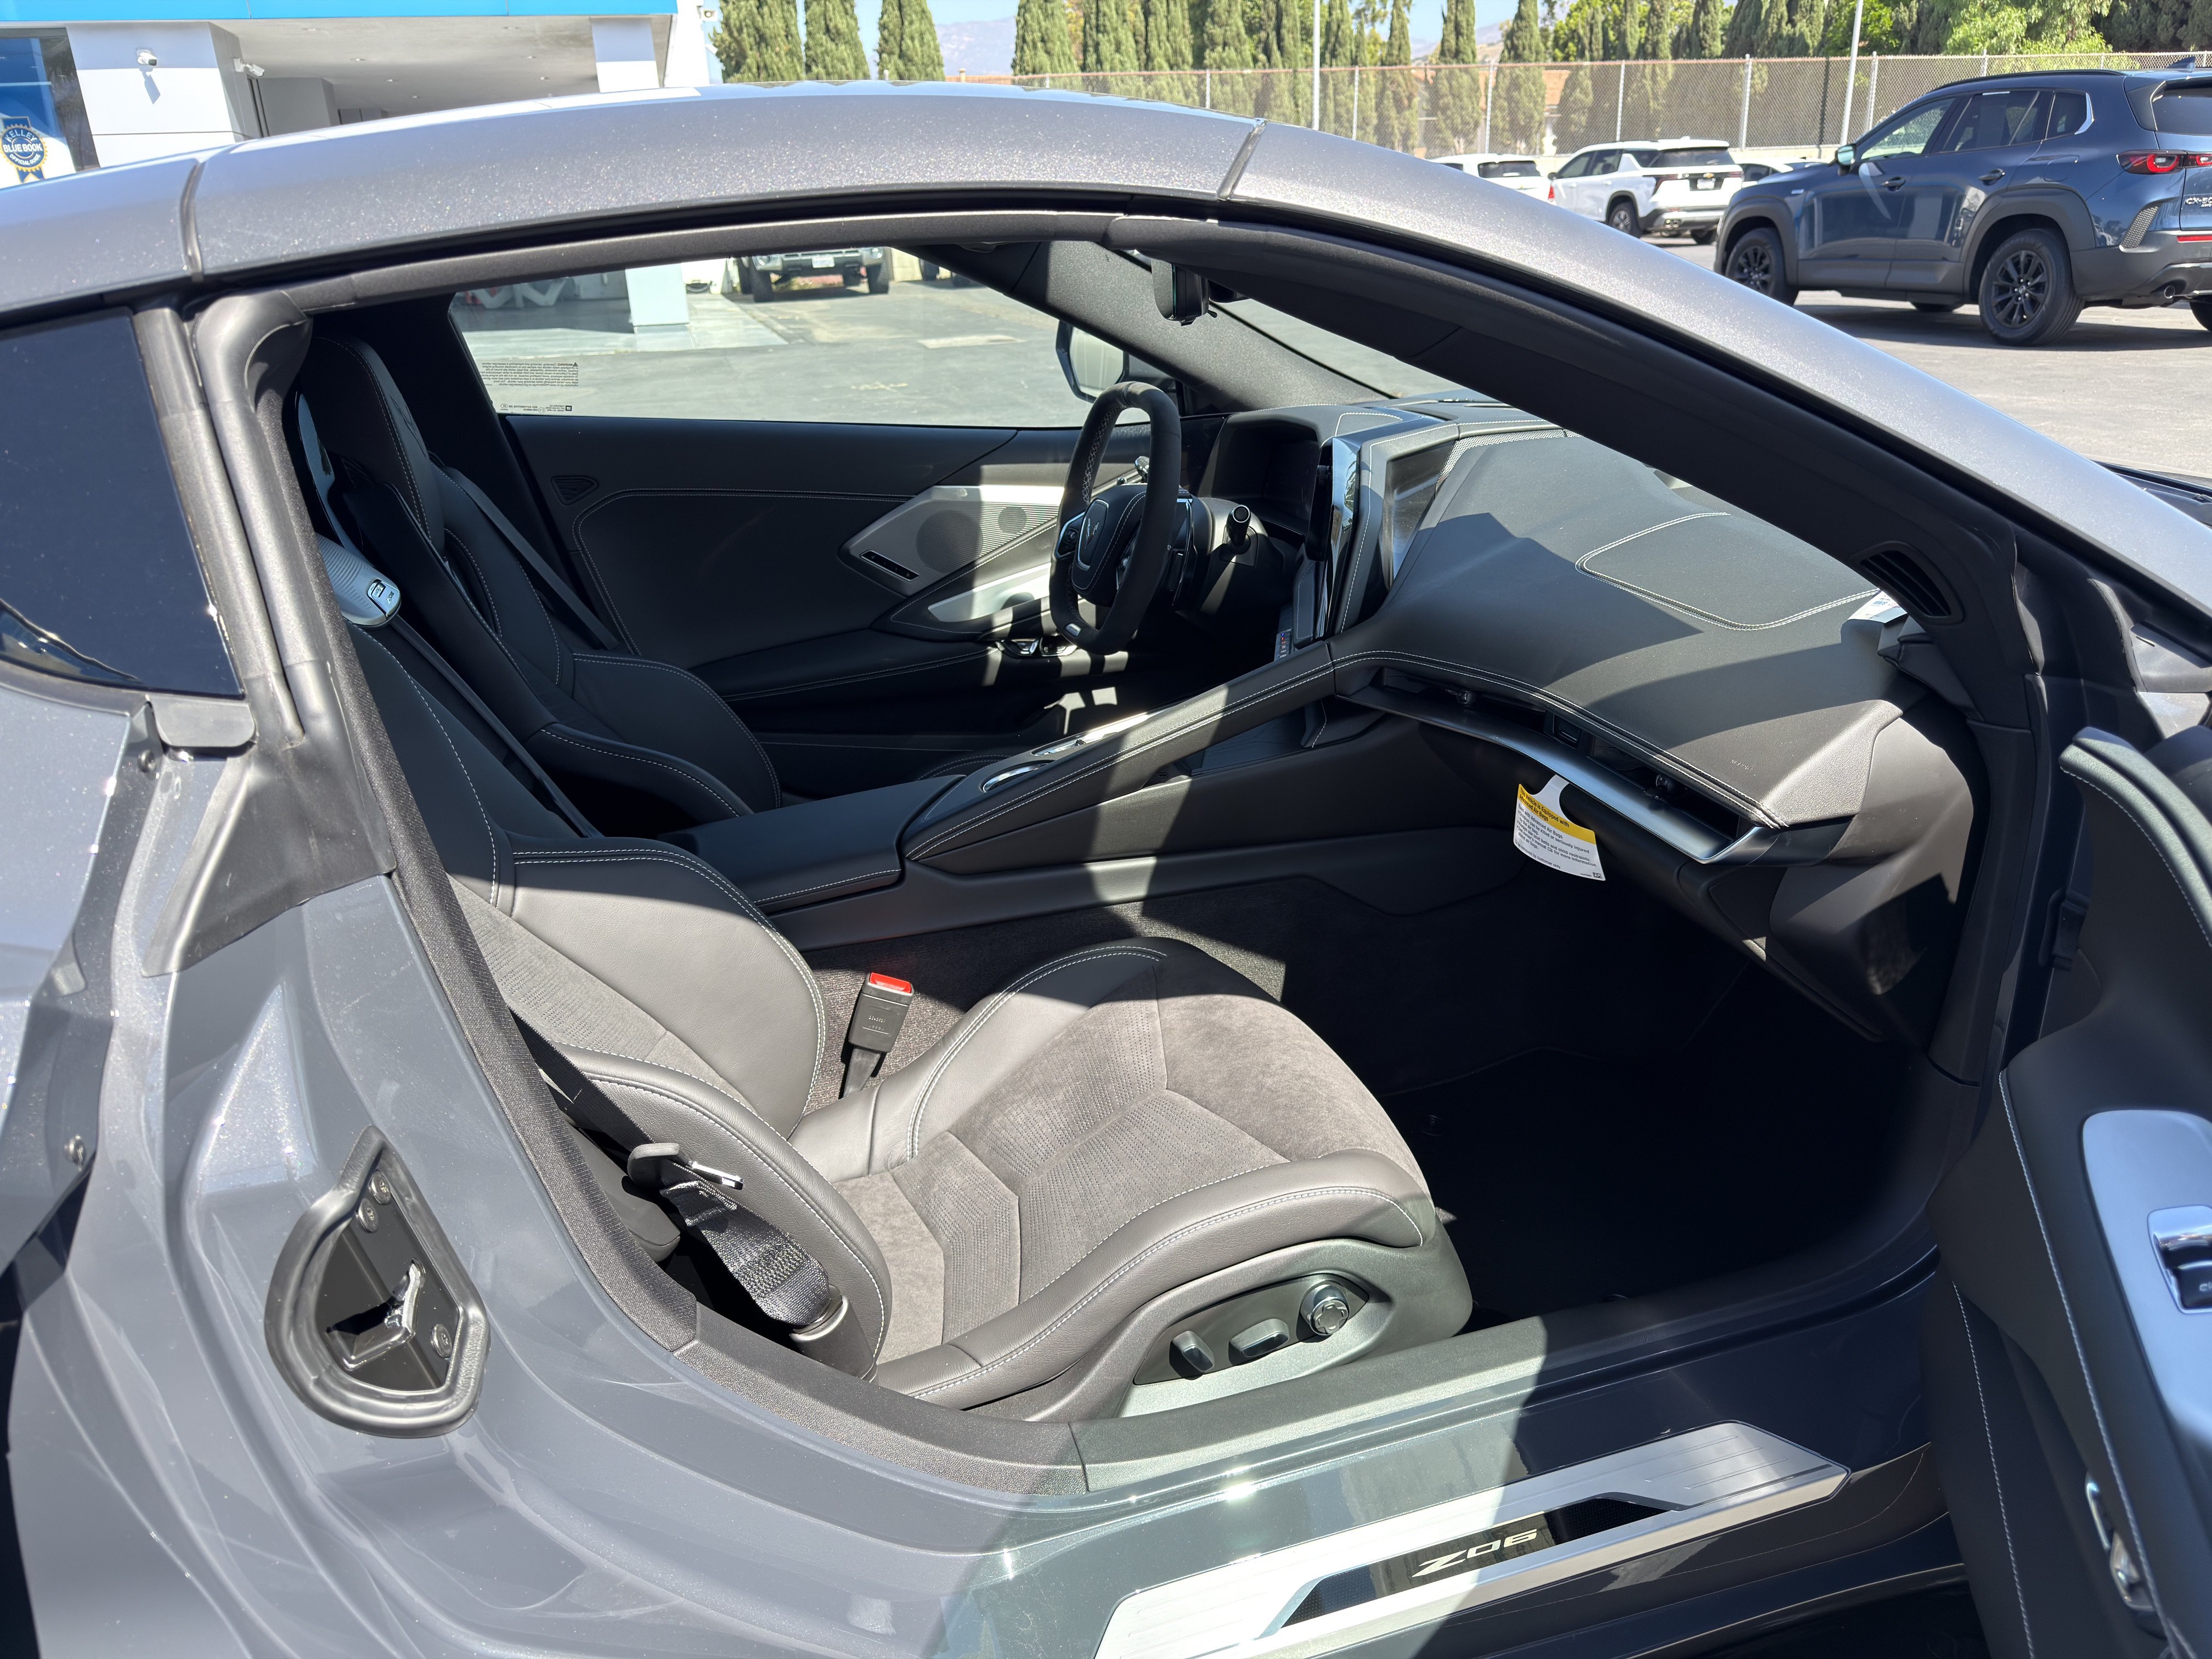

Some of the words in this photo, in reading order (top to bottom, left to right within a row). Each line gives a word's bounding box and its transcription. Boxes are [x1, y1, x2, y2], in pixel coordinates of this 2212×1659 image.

[4, 129, 37, 142] KELLEY
[3, 144, 22, 153] BLUE
[22, 143, 43, 151] BOOK
[9, 154, 30, 165] OFFICIAL
[1520, 793, 1533, 810] Advanced
[1539, 811, 1549, 821] Bags
[1526, 793, 1537, 806] Vehicle
[1542, 806, 1559, 821] Equipped
[1559, 819, 1569, 827] with
[1531, 816, 1546, 830] Advanced
[1541, 828, 1550, 837] killed
[1555, 838, 1573, 848] seriously
[1574, 845, 1589, 854] injured
[1534, 840, 1547, 849] manual
[1571, 856, 1596, 867] information
[1537, 856, 1552, 865] customer
[1569, 852, 1591, 862] restraints.
[1412, 1528, 1537, 1577] Z06
